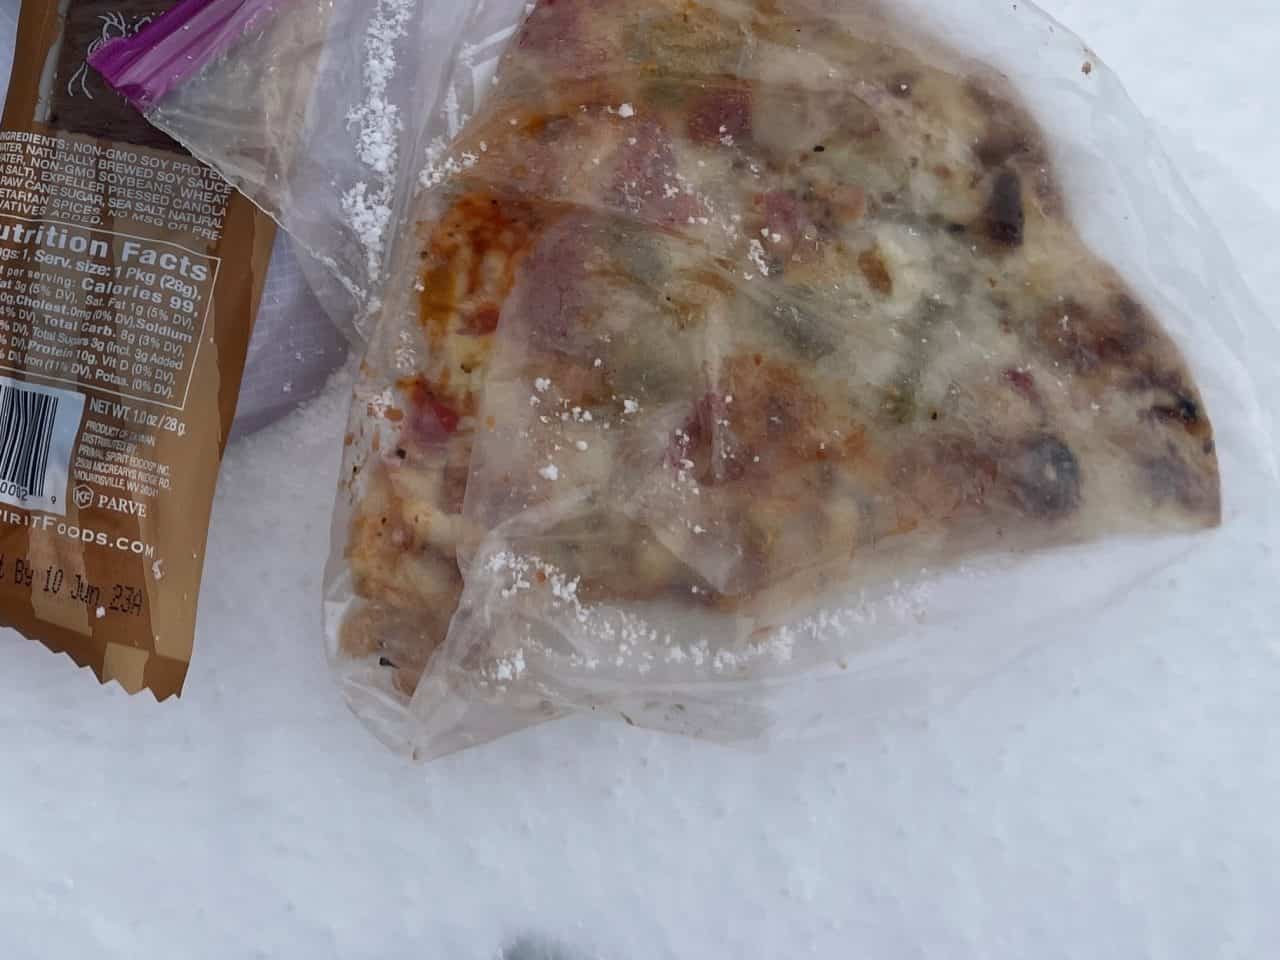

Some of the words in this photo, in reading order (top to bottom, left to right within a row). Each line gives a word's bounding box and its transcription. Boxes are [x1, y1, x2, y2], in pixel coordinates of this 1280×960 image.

[0, 131, 70, 150] INGREDIENTS:
[74, 142, 137, 164] NON-GMO
[140, 155, 170, 169] SOY
[26, 143, 97, 166] NATURALLY
[98, 160, 153, 178] BREWED
[156, 172, 185, 185] SOY
[30, 159, 96, 179] NON-GMO
[0, 175, 24, 187] RAW
[25, 179, 59, 196] CANE
[60, 188, 105, 207] SUGAR,
[107, 198, 132, 209] SEA
[168, 209, 223, 229] NATURAL
[40, 171, 105, 193] EXPELLER
[107, 185, 170, 206] PRESSED
[172, 198, 227, 216] CANOLA
[107, 209, 128, 218] NO
[34, 249, 72, 269] Serv.
[75, 260, 111, 277] size:
[114, 266, 122, 278] 1
[126, 267, 156, 286] Pkg
[121, 240, 208, 281] Facts
[81, 277, 162, 304] Calories
[169, 295, 199, 318] 99,
[108, 297, 126, 310] Fat
[130, 301, 145, 316] 1g
[43, 314, 78, 331] Total
[81, 322, 117, 338] Carb.
[120, 329, 135, 345] 8g
[102, 354, 117, 368] Vit
[119, 359, 129, 371] D
[89, 397, 112, 415] NET
[98, 495, 147, 518] PARVE
[43, 565, 64, 594] 10
